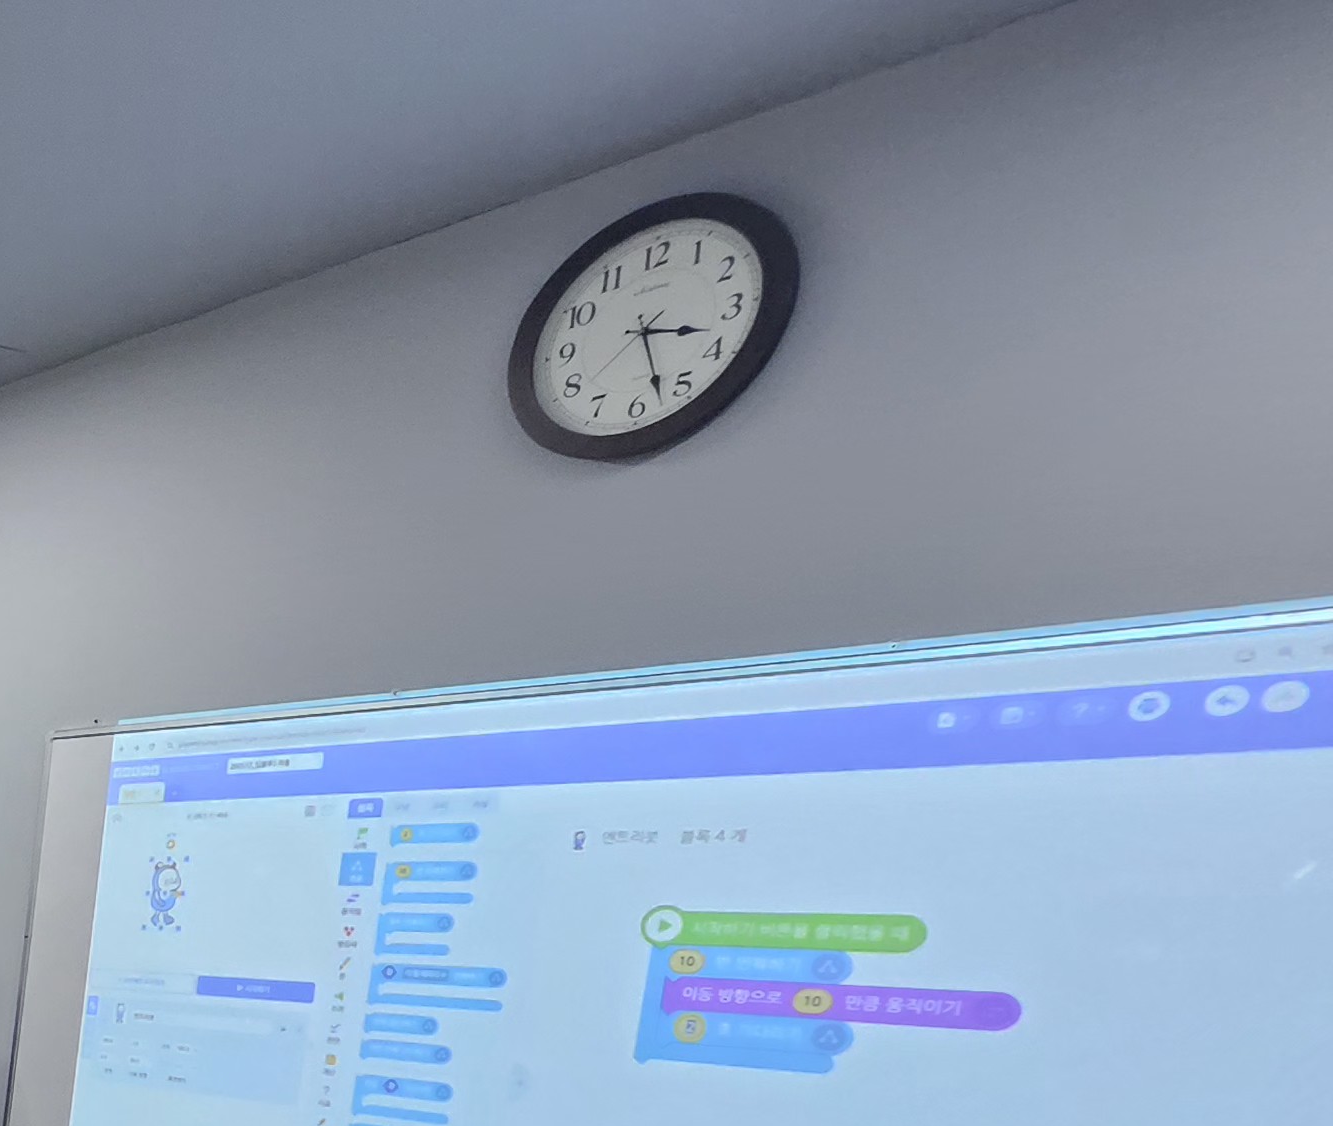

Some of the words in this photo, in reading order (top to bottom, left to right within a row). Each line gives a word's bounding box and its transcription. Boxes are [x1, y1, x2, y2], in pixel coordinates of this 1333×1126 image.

[644, 241, 670, 271] 12
[693, 240, 703, 265] 1
[600, 265, 623, 293] 11
[717, 256, 735, 283] 2
[564, 301, 596, 329] 10
[721, 292, 743, 320] 3
[559, 343, 576, 367] 9
[702, 336, 723, 361] 4
[564, 373, 582, 398] 8
[672, 371, 692, 397] 5
[591, 393, 608, 418] 7
[627, 395, 646, 418] 6
[714, 829, 725, 841] 4
[680, 956, 696, 967] 10
[682, 986, 714, 1002] 이동
[718, 988, 783, 1005] 방향으로
[804, 996, 822, 1007] 10
[844, 995, 880, 1012] 만큼
[886, 996, 963, 1017] 움직이기
